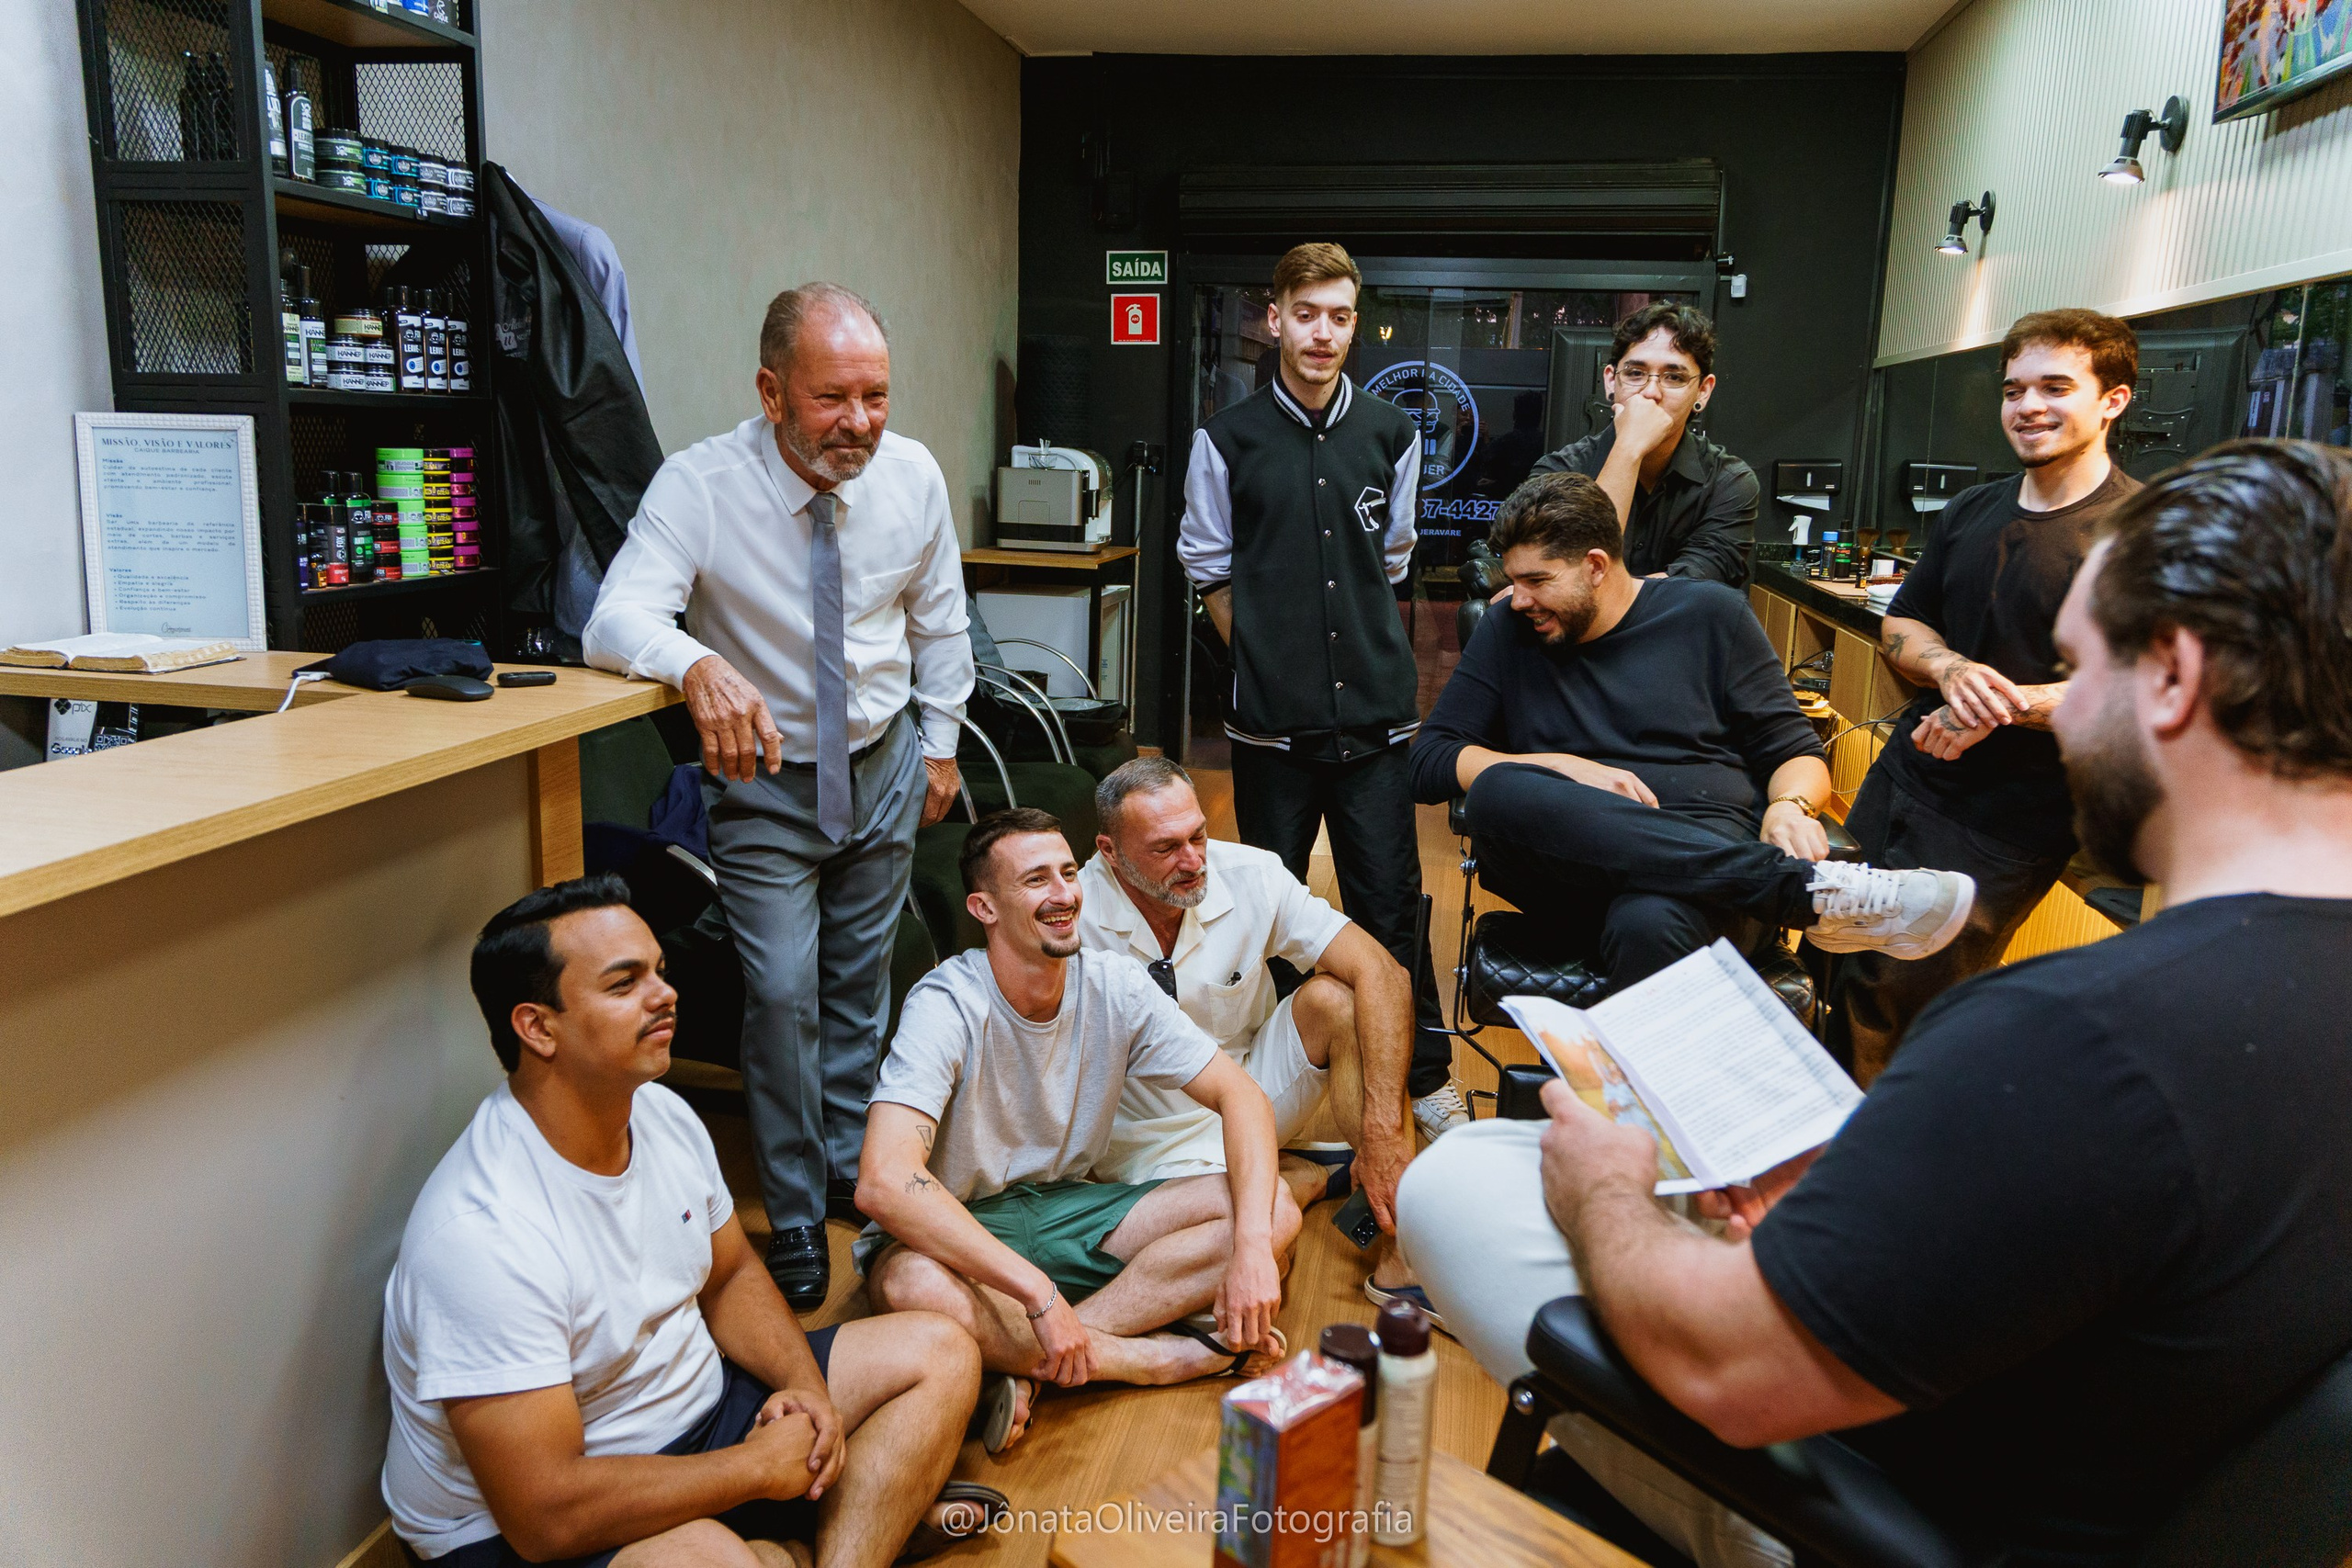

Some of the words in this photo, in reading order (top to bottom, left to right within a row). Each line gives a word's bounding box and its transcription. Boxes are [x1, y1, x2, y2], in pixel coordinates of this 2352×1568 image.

[1112, 258, 1162, 276] SAÍDA
[1371, 369, 1418, 395] MELHOR
[1439, 375, 1470, 411] CIDADE
[144, 438, 174, 447] VISÃO
[187, 440, 231, 449] VALORES
[72, 703, 92, 714] pix
